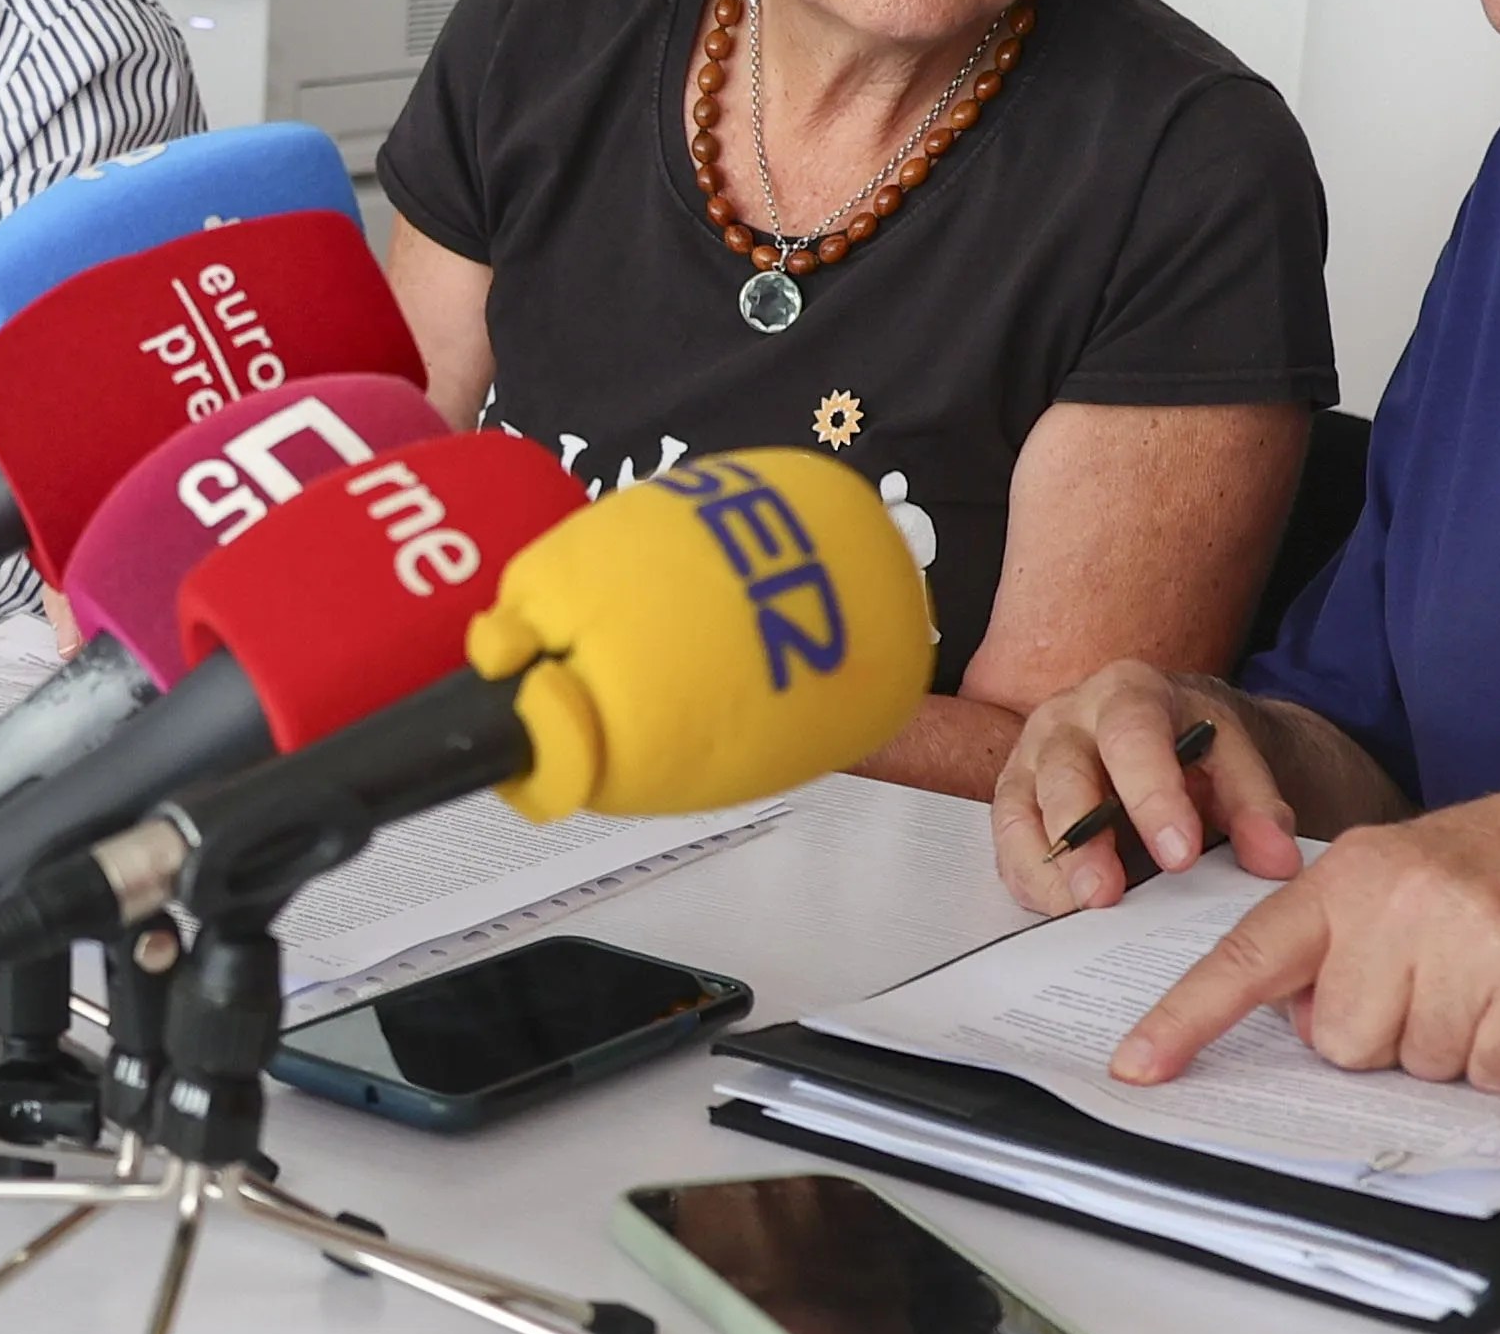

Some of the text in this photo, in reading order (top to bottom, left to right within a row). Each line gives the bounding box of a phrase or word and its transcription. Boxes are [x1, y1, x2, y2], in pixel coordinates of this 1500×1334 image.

[199, 264, 286, 392] euro
[345, 461, 482, 598] rne
[649, 460, 847, 693] SER
